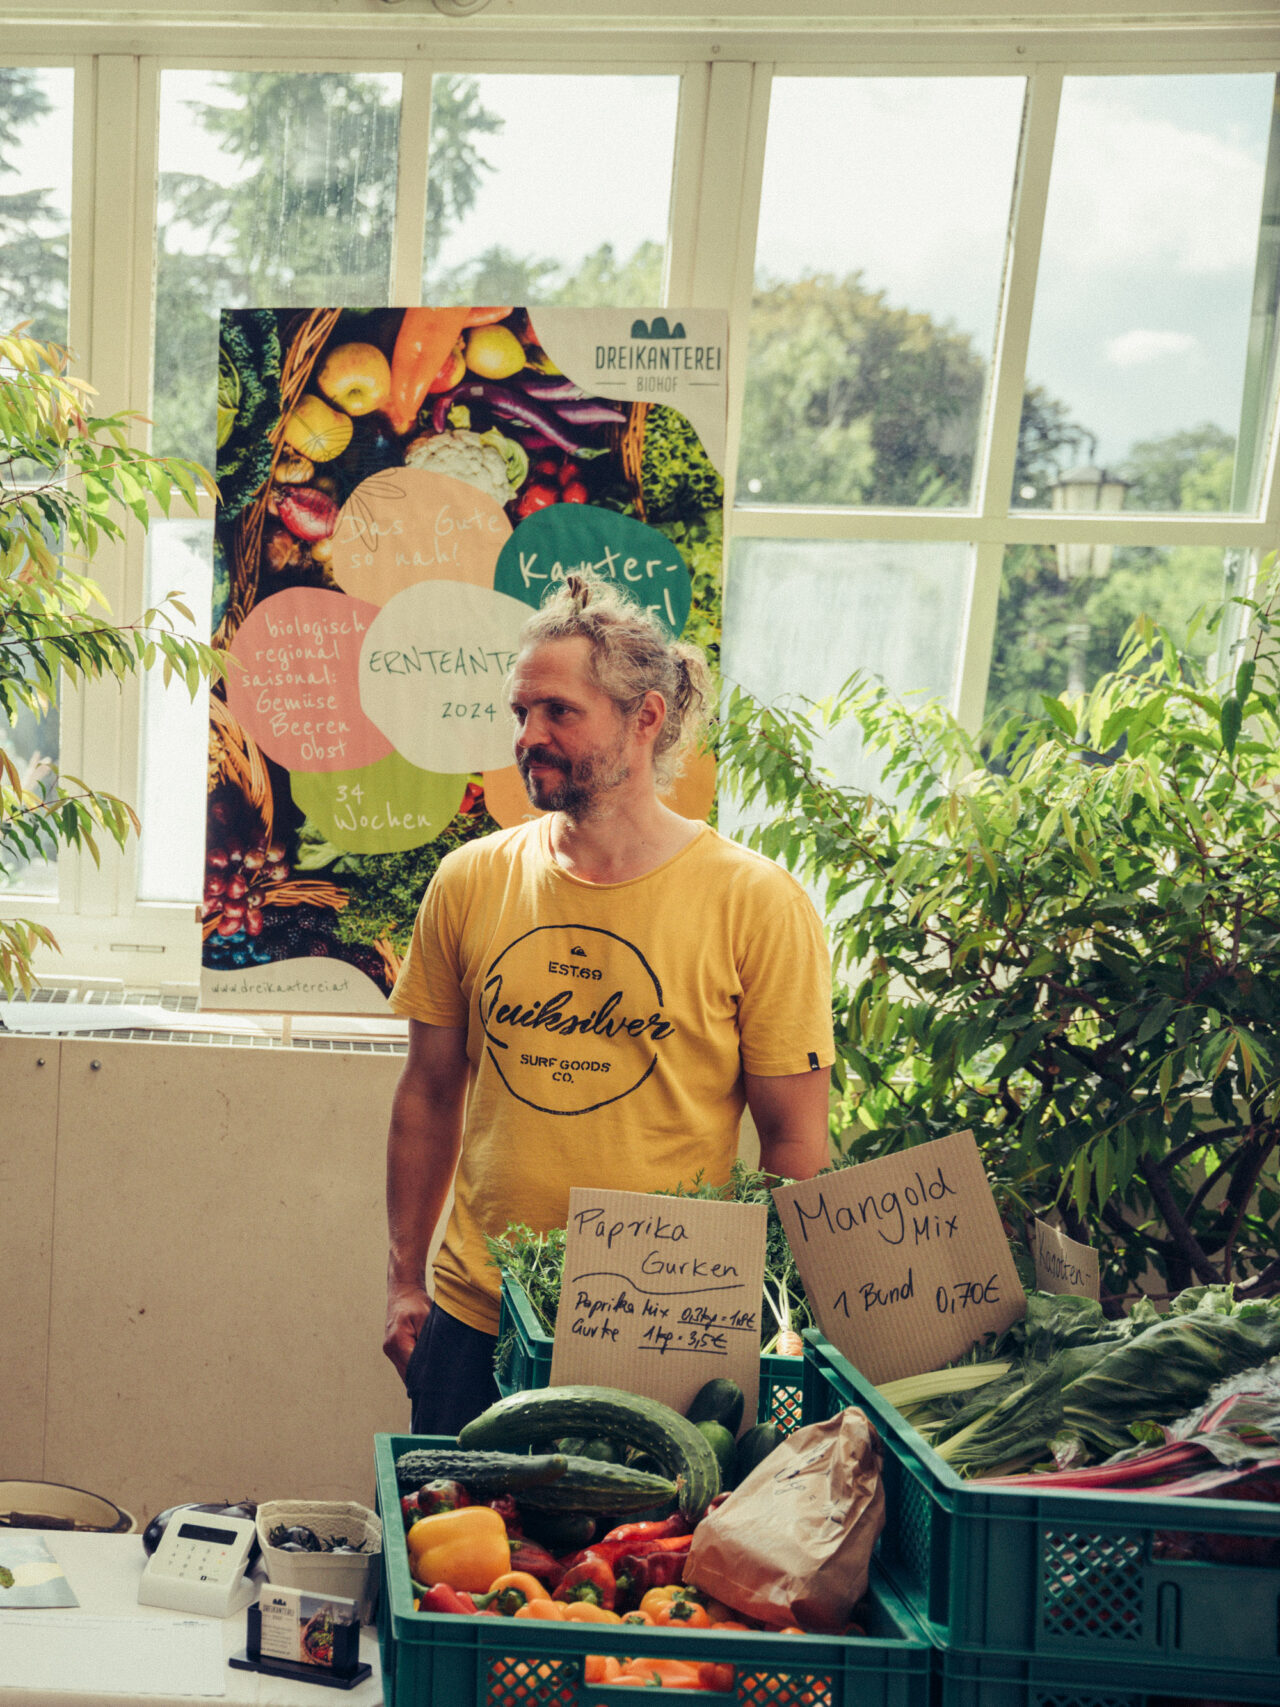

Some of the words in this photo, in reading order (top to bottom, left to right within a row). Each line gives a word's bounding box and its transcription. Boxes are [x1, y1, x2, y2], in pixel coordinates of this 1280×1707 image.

[595, 345, 722, 371] DREIKANTEREI
[636, 376, 678, 392] BIOHOF
[340, 515, 404, 544] Das
[434, 504, 503, 537] Gute
[350, 553, 374, 569] so
[395, 535, 460, 567] nah!
[264, 609, 366, 645] biologisch
[255, 639, 340, 671] regional
[369, 645, 519, 676] ERNTEANTE
[242, 664, 337, 687] saisonal:
[256, 689, 338, 713] Gemüse
[442, 702, 496, 722] 2024
[270, 712, 350, 737] Beeren
[301, 735, 347, 760] Obst
[336, 784, 365, 805] 34
[334, 801, 432, 831] Wochen
[548, 961, 603, 981] EST.69
[520, 1054, 558, 1068] SURF
[560, 1060, 612, 1073] GOODS
[552, 1071, 575, 1084] CO.
[793, 1167, 957, 1245] Mangold
[574, 1208, 689, 1249] Paprika
[913, 1215, 958, 1245] Mix
[641, 1250, 739, 1278] Gurken
[575, 1291, 635, 1319] Paprika
[833, 1290, 850, 1319] 1
[859, 1267, 914, 1312] Bund
[935, 1274, 1001, 1315] 0,70€
[571, 1317, 620, 1343] Gurke
